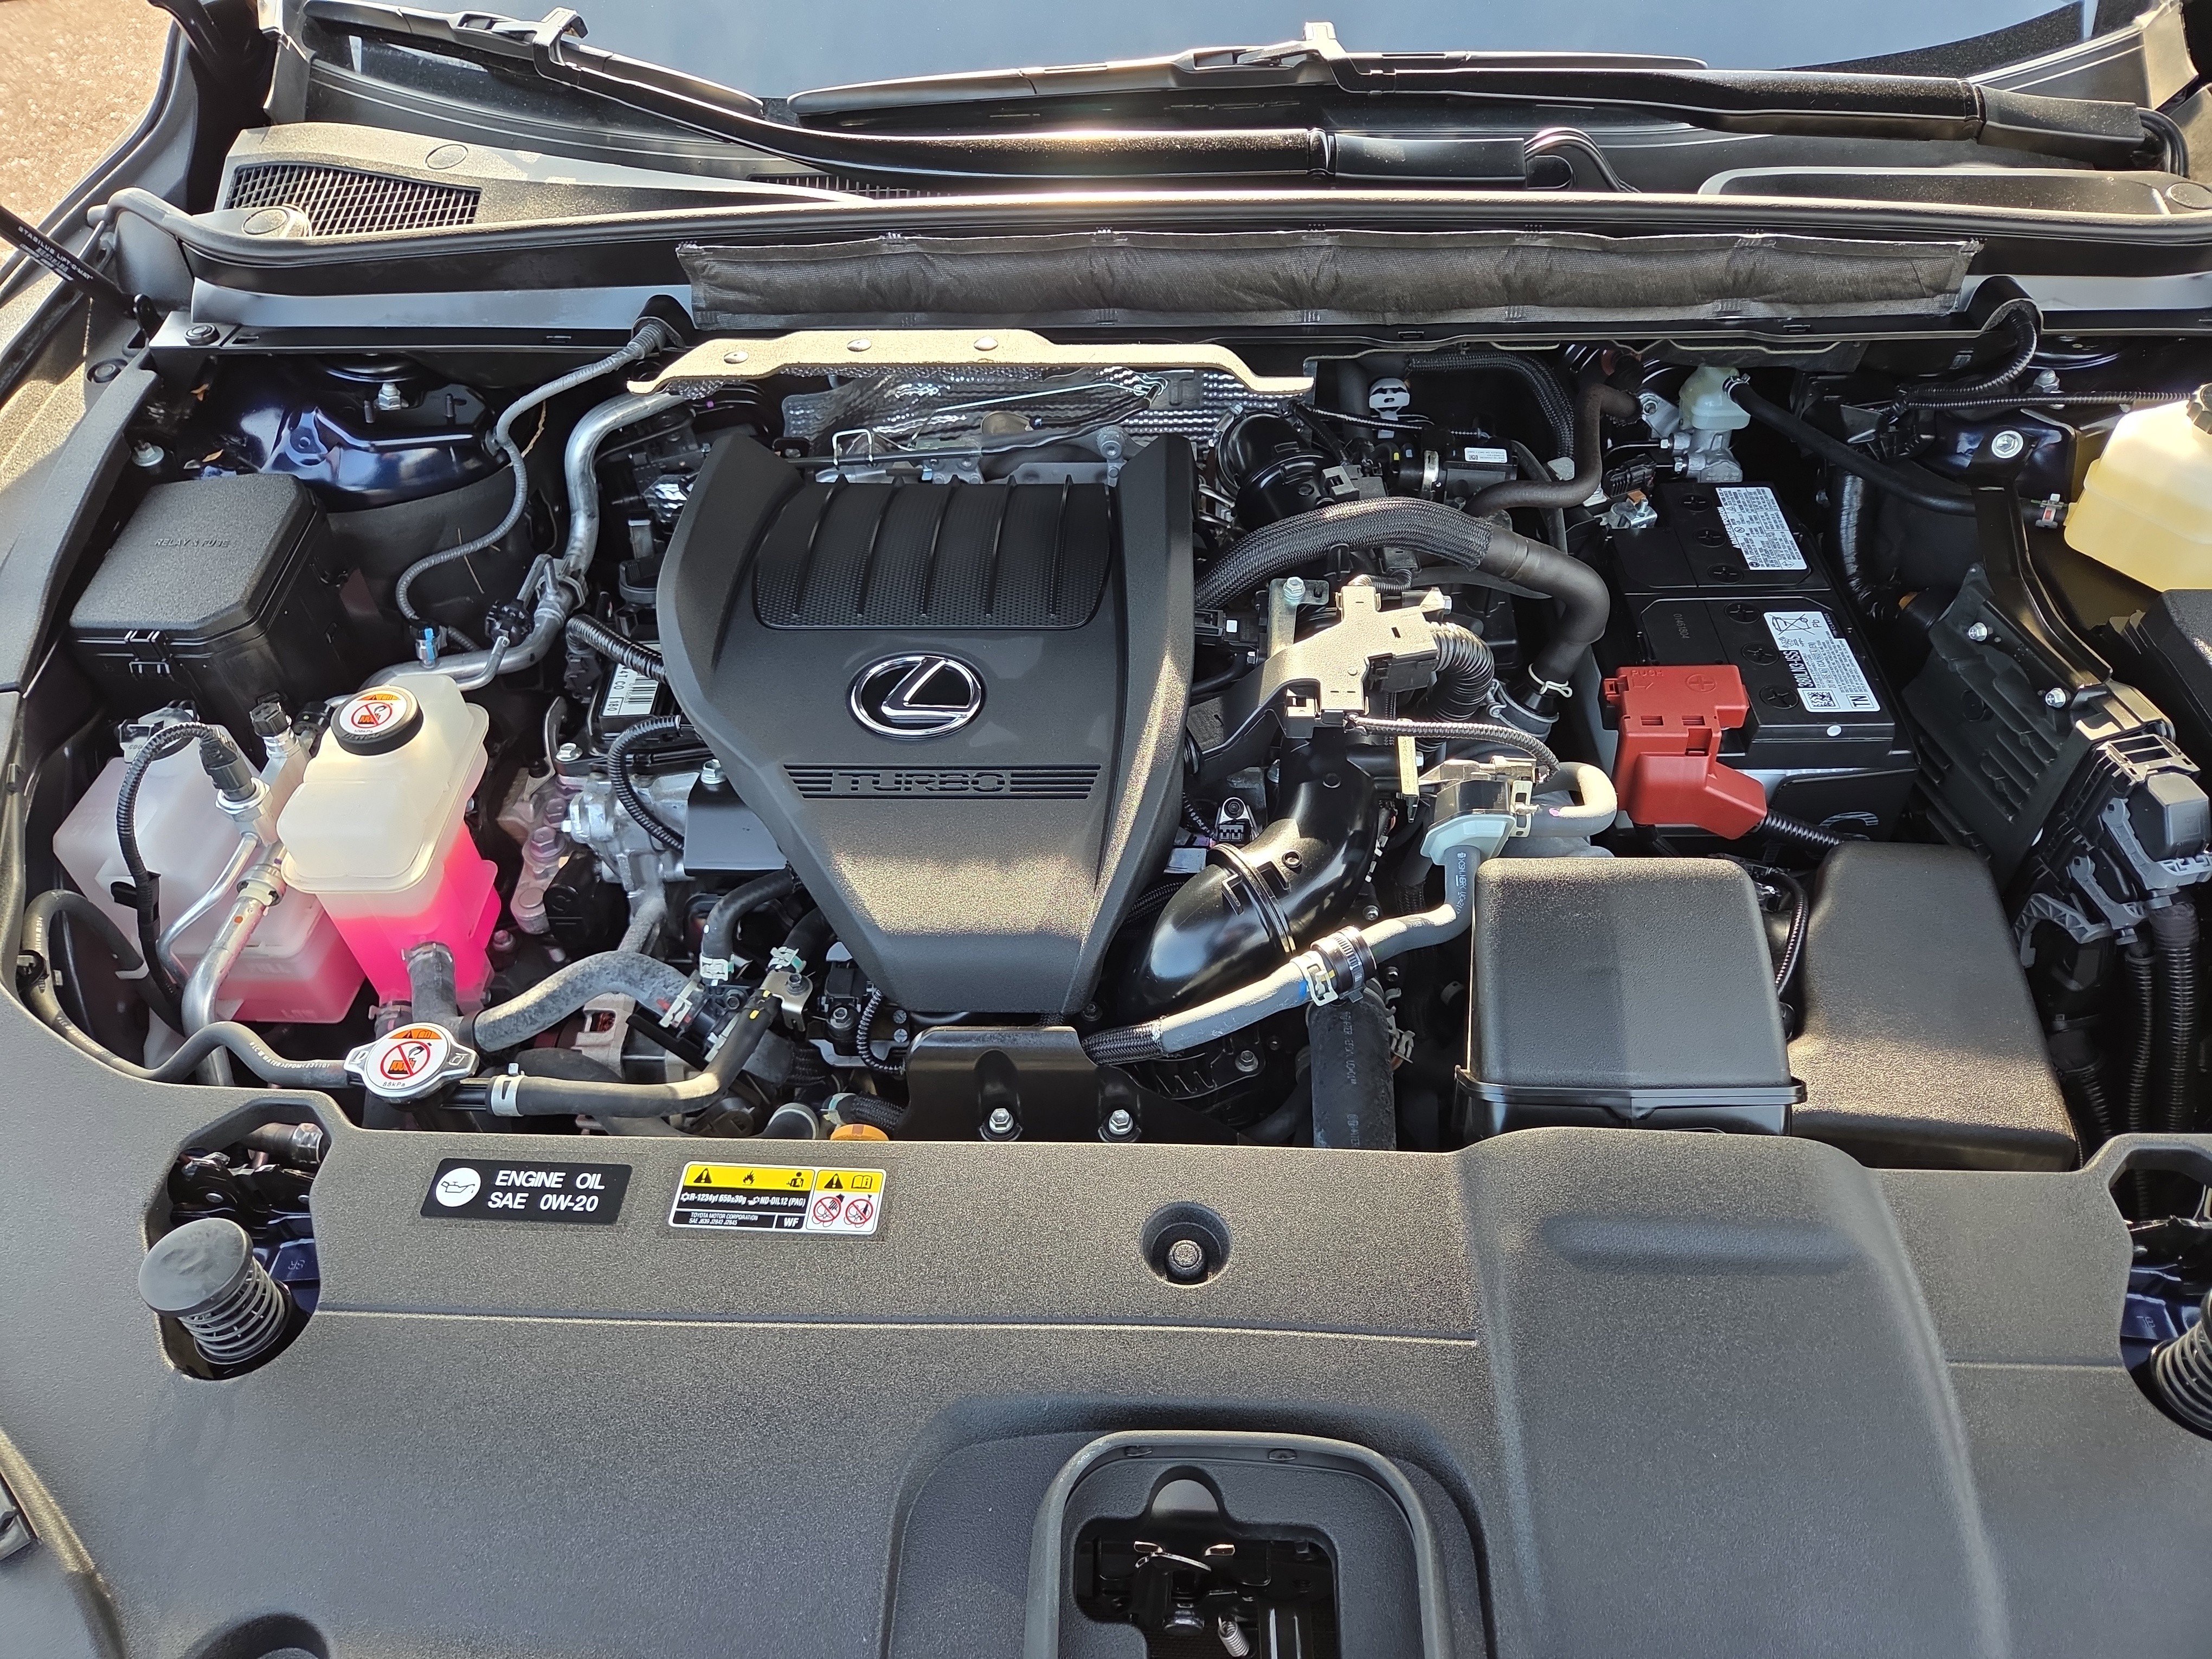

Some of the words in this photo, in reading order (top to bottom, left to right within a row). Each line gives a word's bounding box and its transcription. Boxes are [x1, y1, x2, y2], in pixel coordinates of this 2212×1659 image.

[1811, 619, 1822, 628] Pb
[1783, 651, 1814, 687] 380LN3-ISS
[1849, 695, 1870, 707] TN
[838, 771, 1006, 792] TURBO
[495, 1170, 566, 1188] ENGINE
[576, 1173, 605, 1189] OIL
[488, 1192, 529, 1209] SAE
[539, 1194, 599, 1212] 0W-20
[783, 1217, 800, 1227] WF
